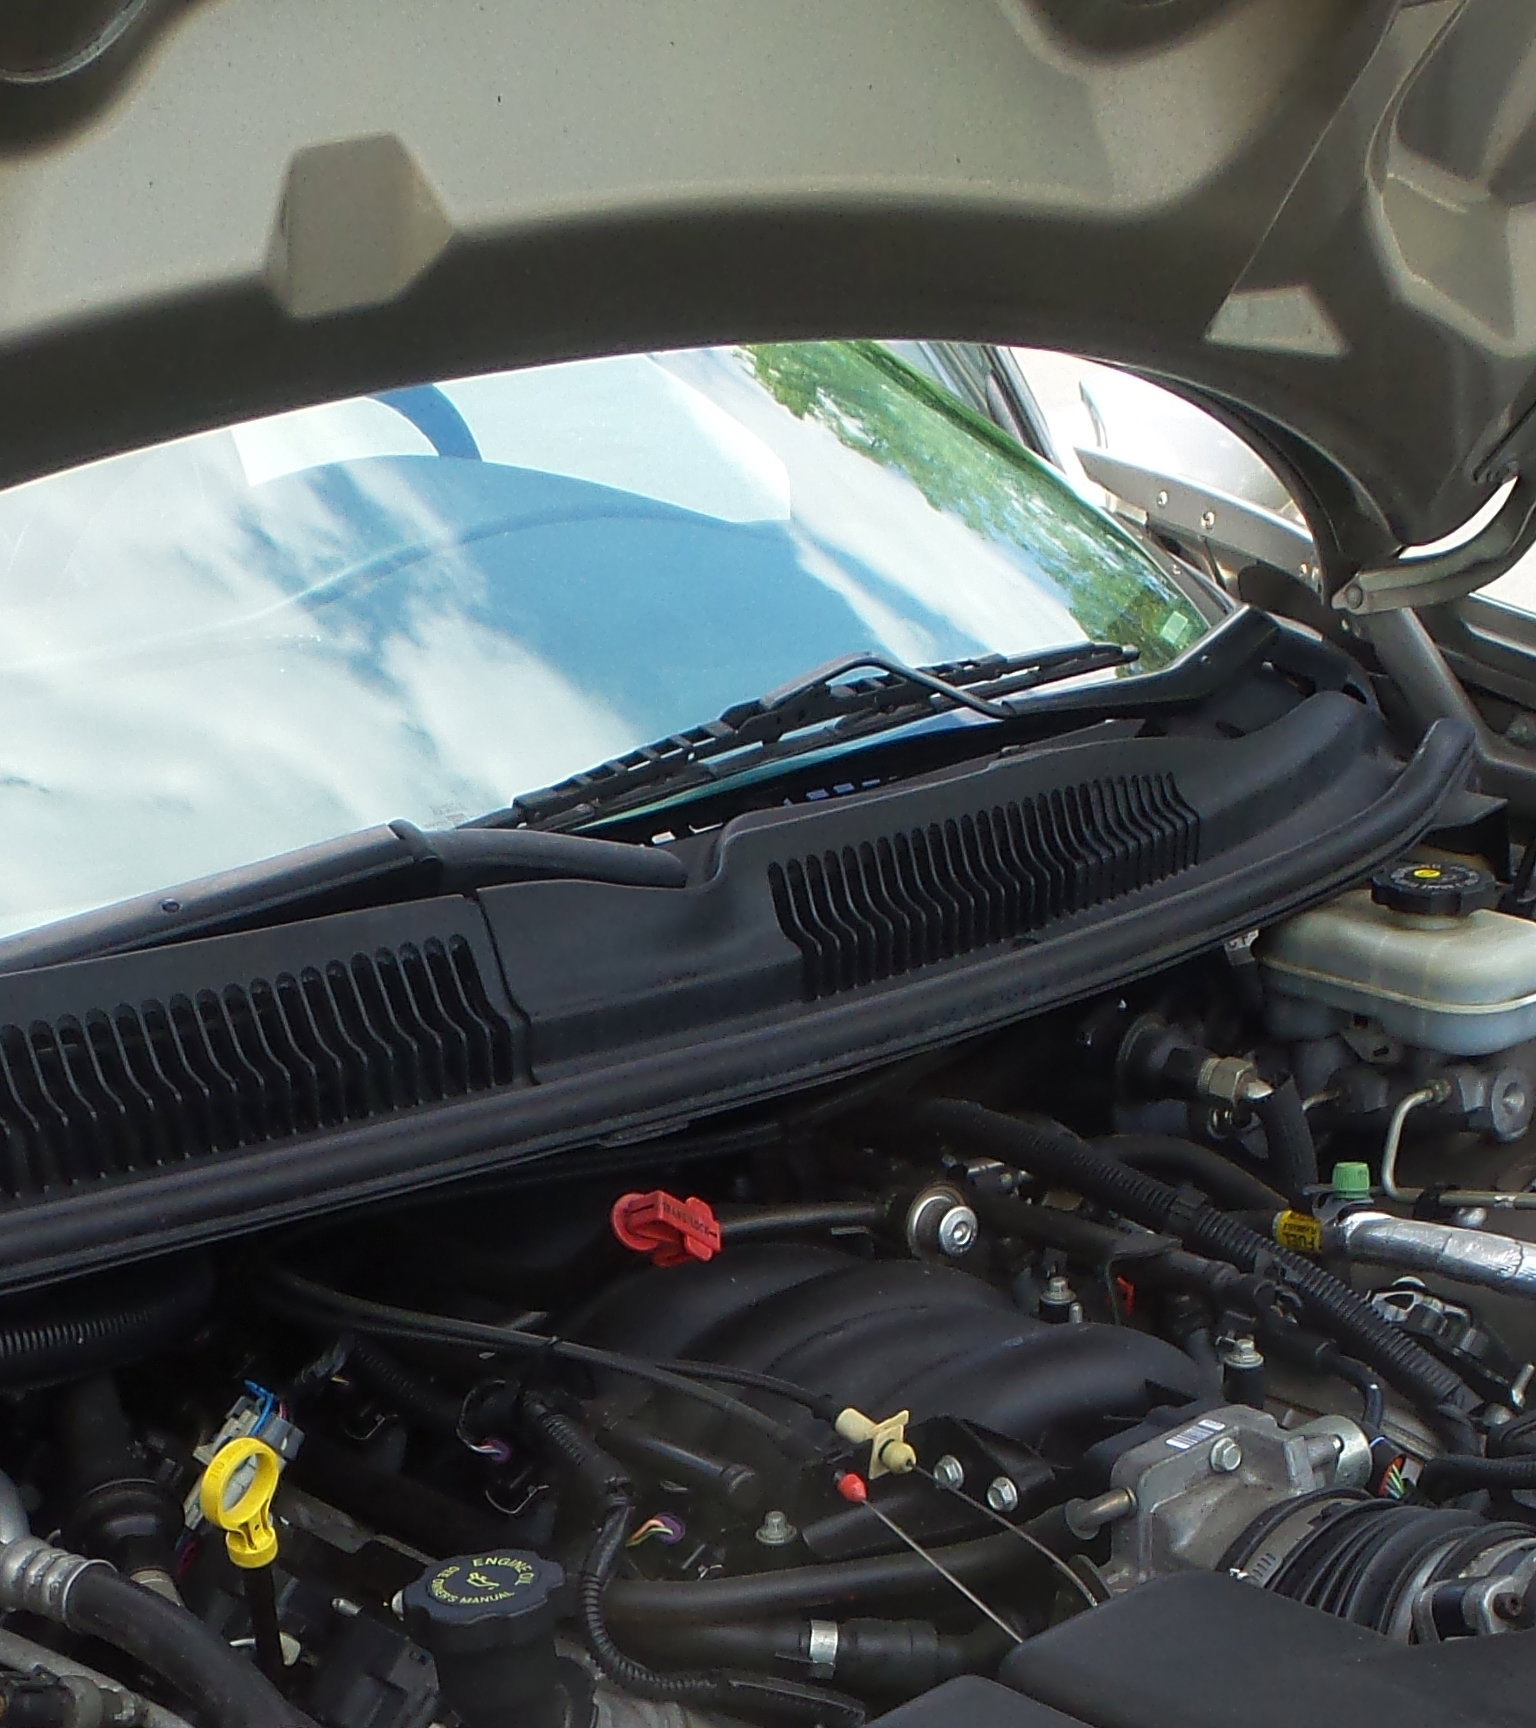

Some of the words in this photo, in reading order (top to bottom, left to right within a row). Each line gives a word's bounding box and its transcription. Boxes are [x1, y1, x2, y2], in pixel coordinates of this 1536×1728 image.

[1283, 1232, 1315, 1251] FUEL
[472, 1556, 532, 1573] ENGINE
[459, 1590, 516, 1604] MANUAL
